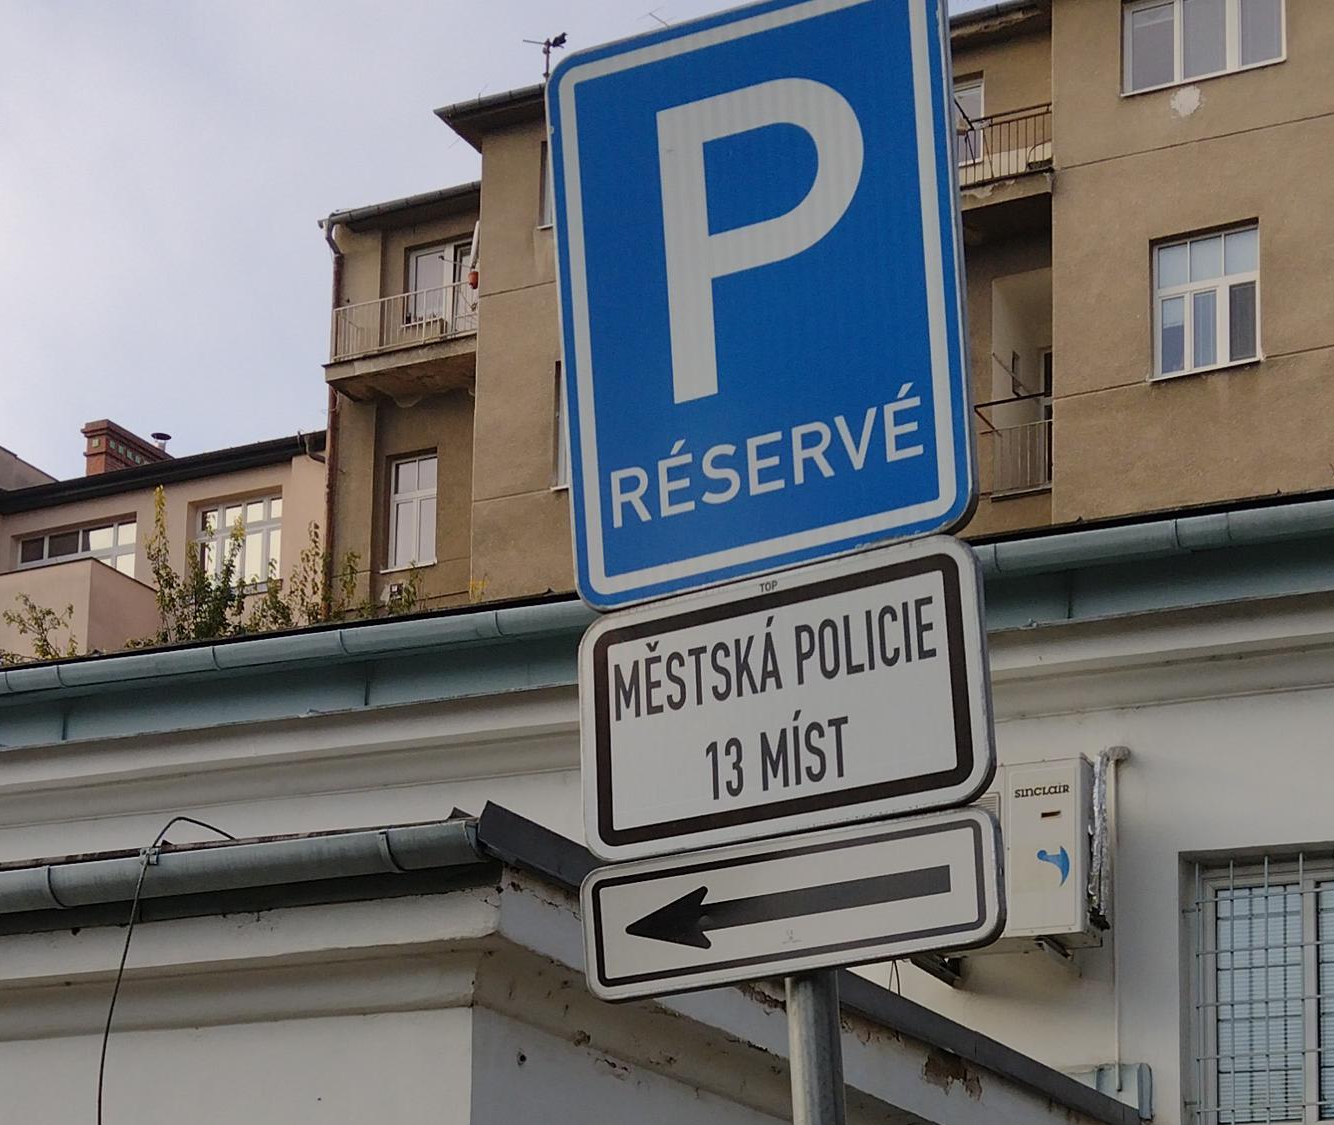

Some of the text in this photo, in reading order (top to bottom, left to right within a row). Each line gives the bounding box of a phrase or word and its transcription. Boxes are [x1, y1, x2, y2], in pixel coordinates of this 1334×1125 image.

[655, 77, 865, 405] P
[609, 381, 925, 529] RÉSERVÉ
[758, 579, 778, 593] TOP
[613, 595, 938, 722] MĚSTSKÁ POLICIE
[705, 709, 849, 801] 13 MÍST
